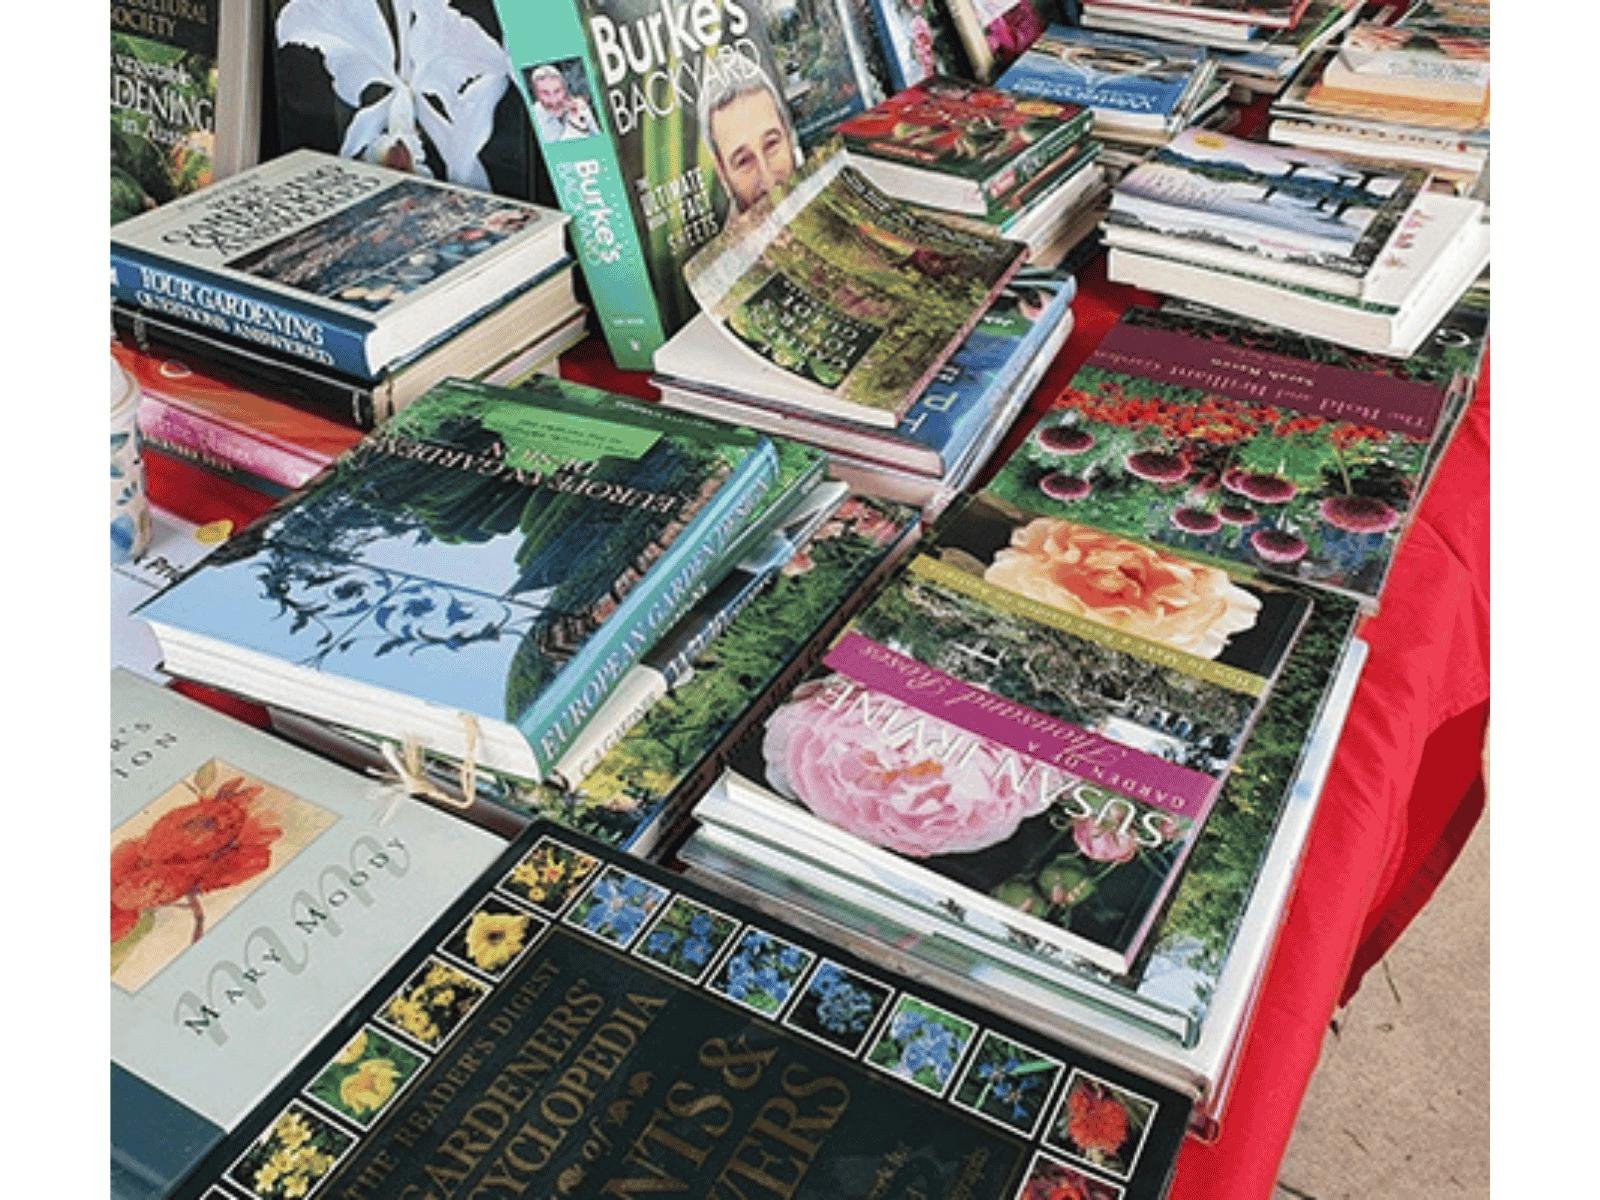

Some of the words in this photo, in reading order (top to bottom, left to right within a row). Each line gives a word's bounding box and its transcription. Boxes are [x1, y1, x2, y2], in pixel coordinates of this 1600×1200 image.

[609, 38, 761, 135] BACKYARD
[576, 160, 624, 265] Burke's
[139, 262, 194, 305] YOUR
[196, 281, 325, 346] GARDENING
[538, 622, 651, 761] EUROPEAN
[815, 676, 971, 768] IRVINE
[1000, 753, 1165, 850] SUSAN
[1091, 761, 1188, 813] GARDEN
[184, 948, 282, 1036] MARY
[295, 837, 406, 935] MOODY
[393, 1033, 496, 1148] READER'S
[489, 957, 562, 1037] DIGEST
[468, 984, 671, 1200] YCLOPEDIA
